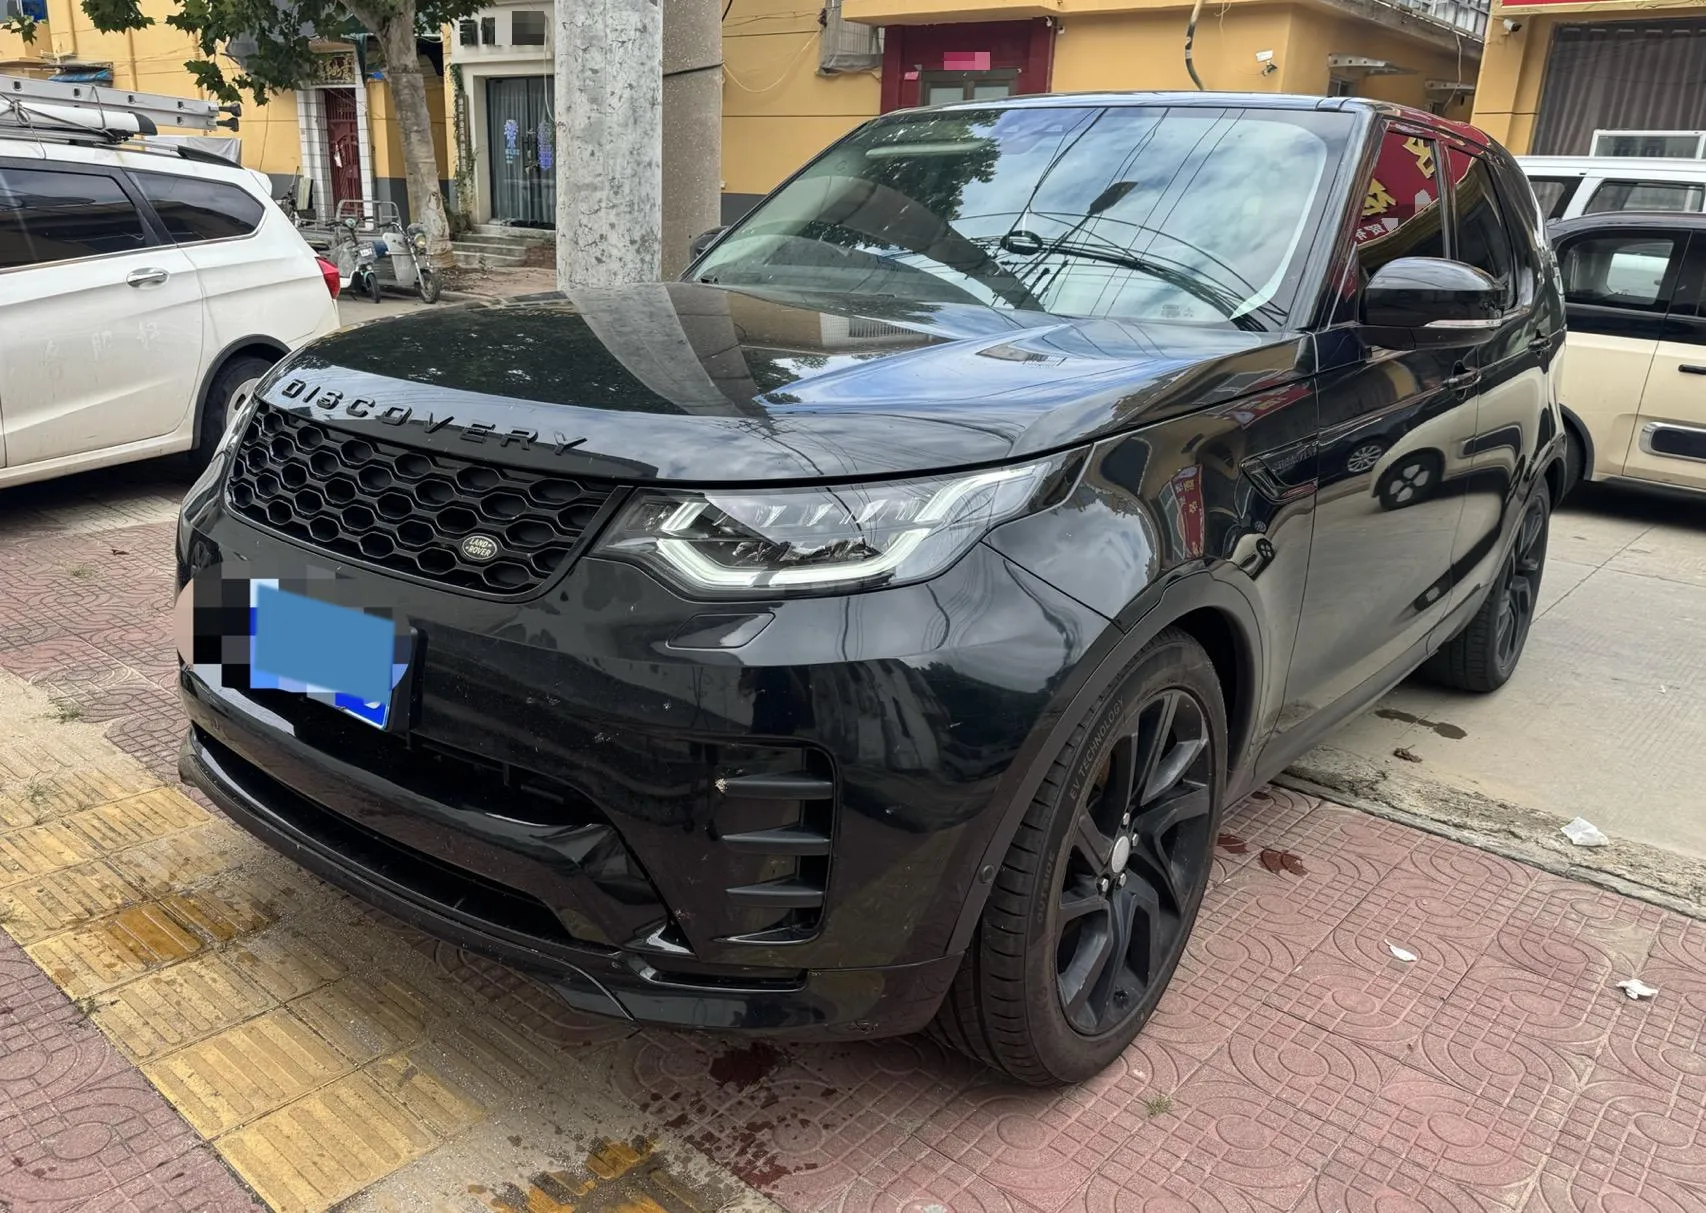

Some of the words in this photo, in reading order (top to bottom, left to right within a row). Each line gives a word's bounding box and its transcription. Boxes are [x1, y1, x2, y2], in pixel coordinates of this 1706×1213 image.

[281, 377, 588, 456] DISCOVERY
[467, 546, 491, 557] ROVER
[469, 538, 488, 547] LAND
[1069, 777, 1081, 800] EV
[1078, 695, 1124, 777] TECHNOLOGY
[1036, 849, 1055, 924] OUTSIDE
